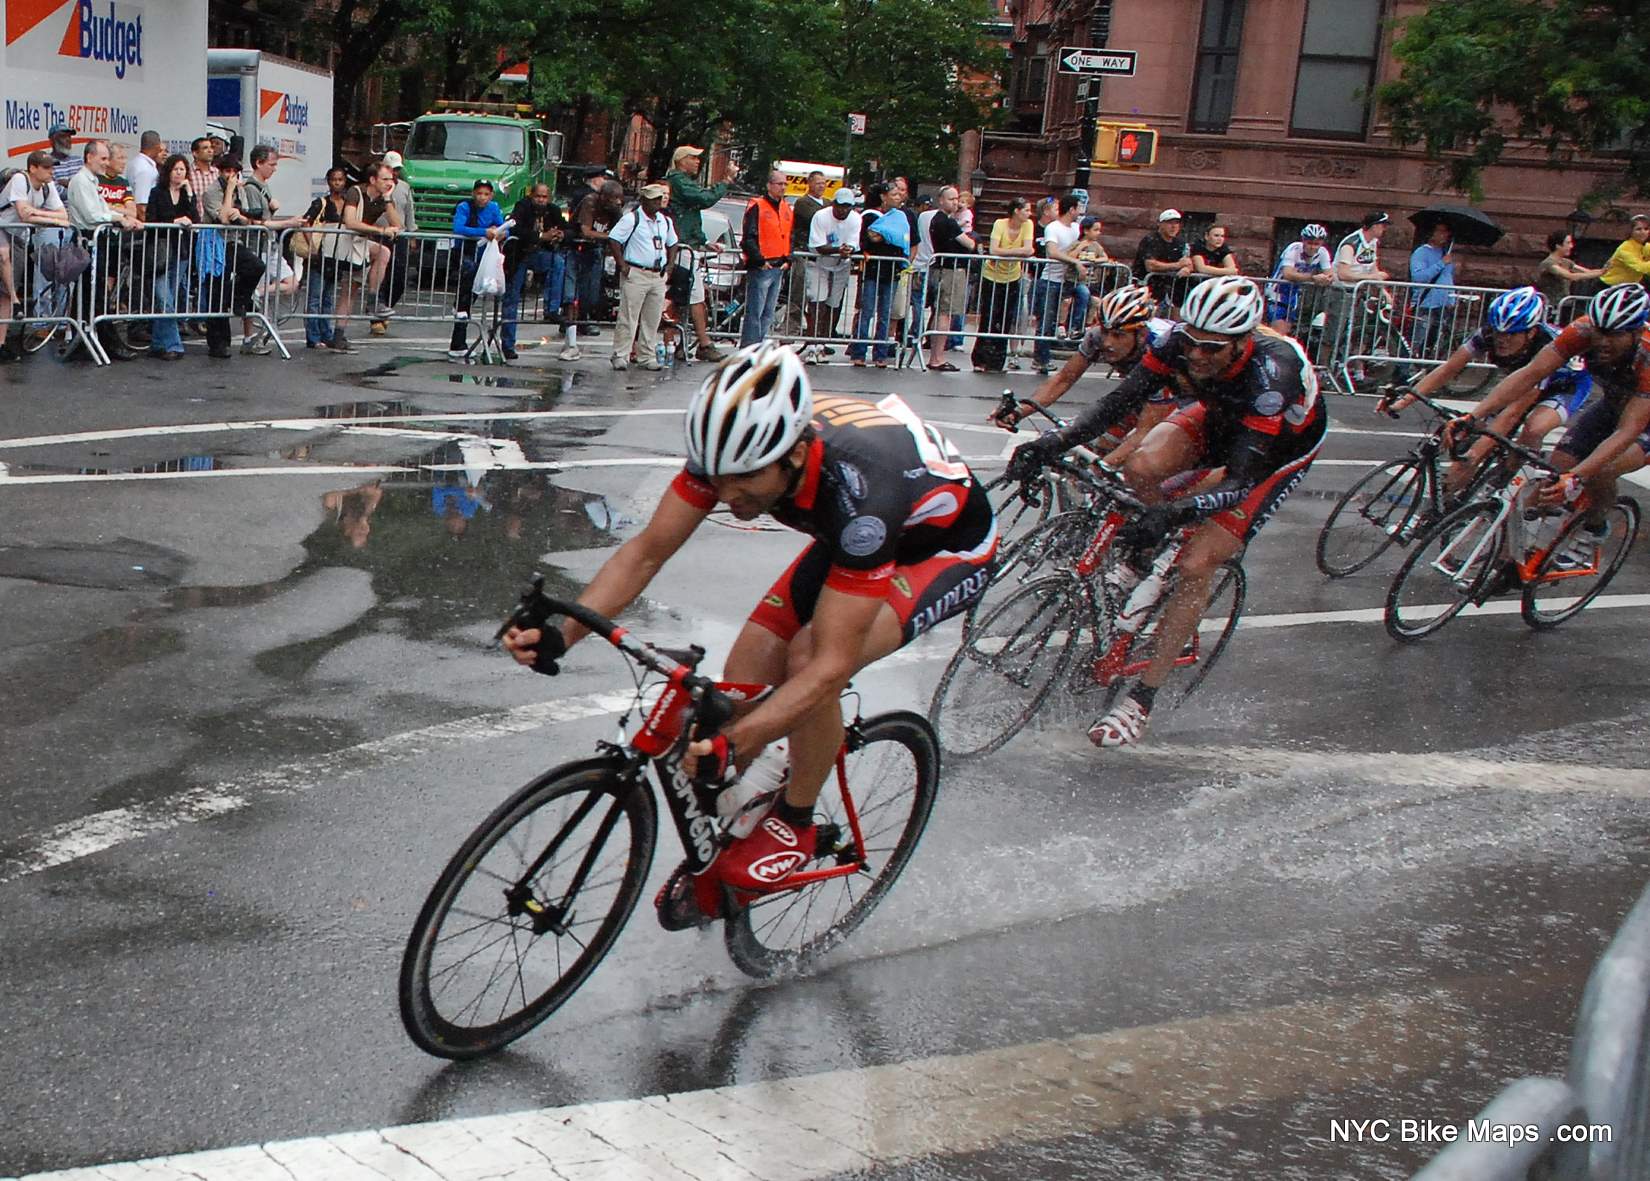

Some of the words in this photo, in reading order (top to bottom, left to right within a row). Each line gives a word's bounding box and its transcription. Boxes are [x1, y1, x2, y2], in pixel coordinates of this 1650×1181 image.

[79, 0, 143, 79] Budget
[1070, 55, 1092, 67] ONE
[1102, 57, 1126, 69] WAY
[5, 100, 40, 131] Make
[43, 102, 66, 128] The
[67, 104, 109, 133] BETTER
[110, 113, 138, 135] Move
[284, 93, 309, 133] Budget
[911, 567, 989, 638] EMPIRE
